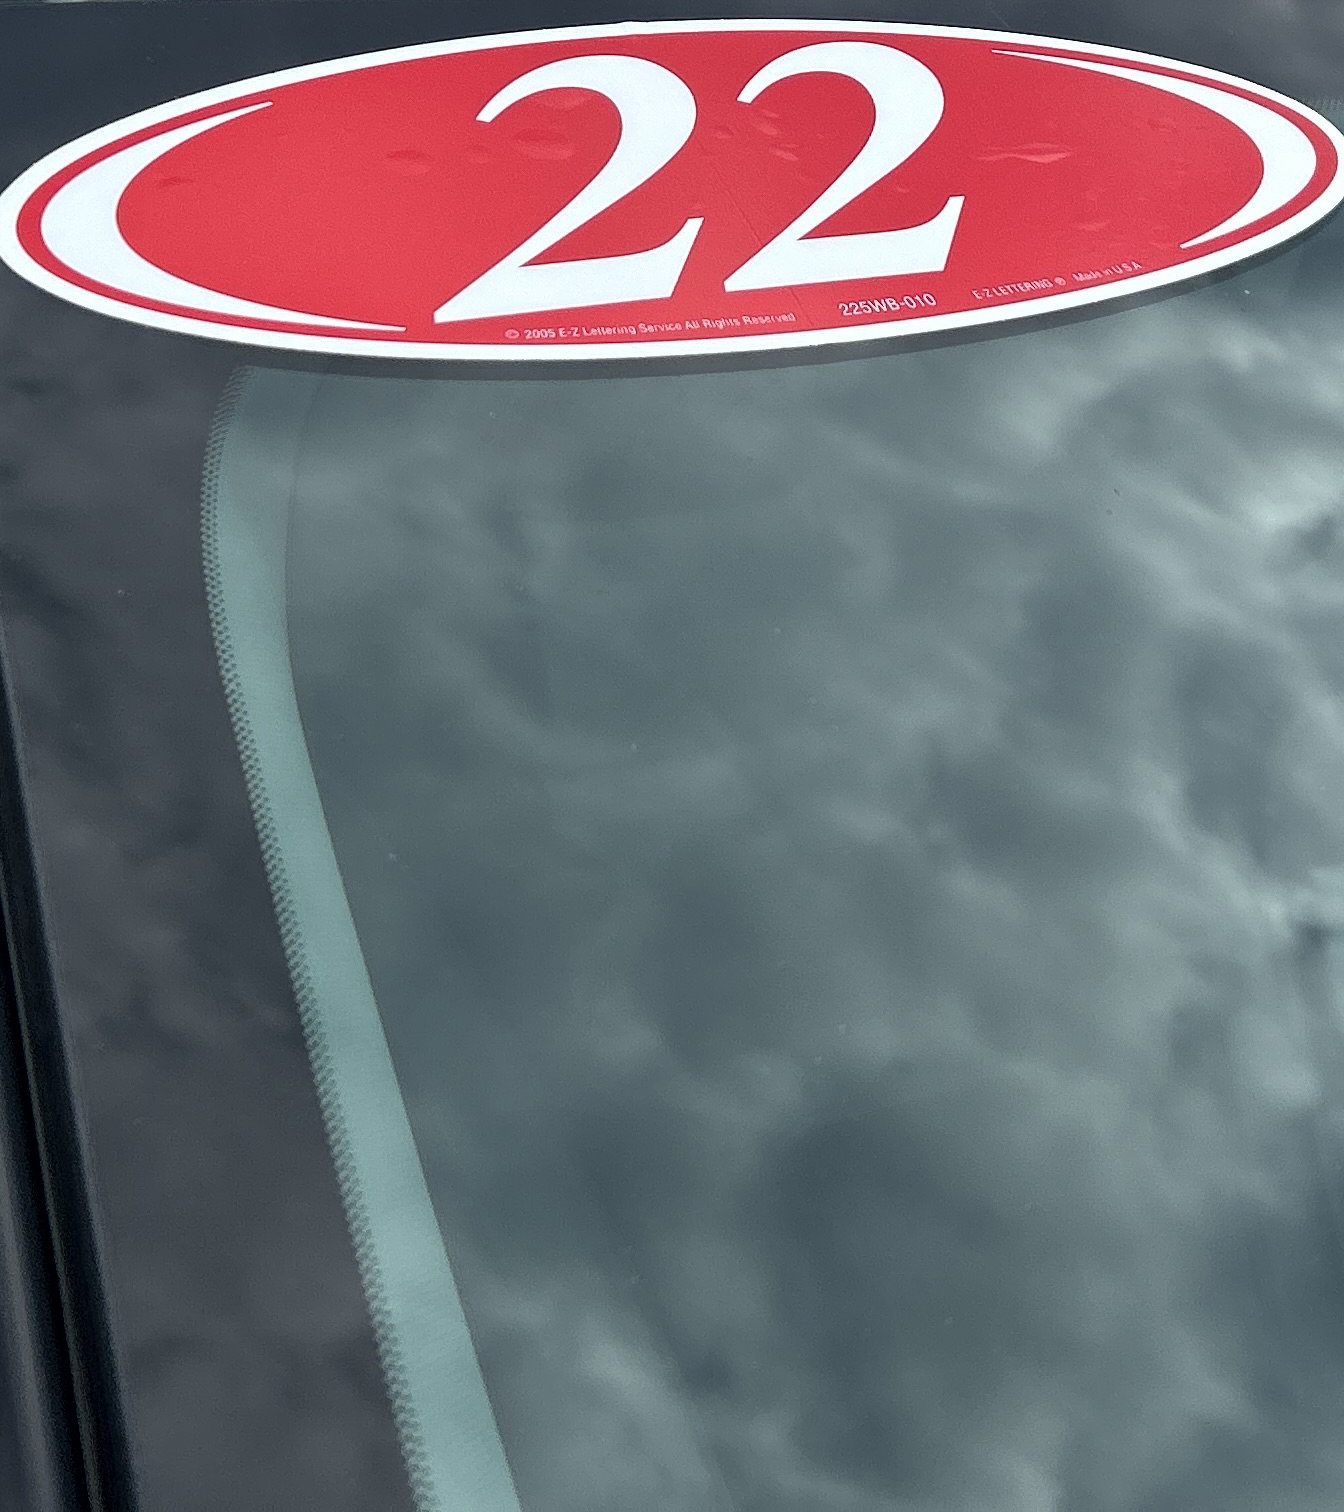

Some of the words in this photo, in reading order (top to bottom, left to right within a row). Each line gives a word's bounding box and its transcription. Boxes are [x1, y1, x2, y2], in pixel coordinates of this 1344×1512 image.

[434, 41, 964, 324] 22
[994, 278, 1053, 297] LETTERING
[838, 292, 937, 316] 225WB-010
[523, 328, 556, 339] 2005
[582, 325, 636, 336] Lettering
[638, 322, 682, 333] Service
[742, 312, 796, 325] Reserved
